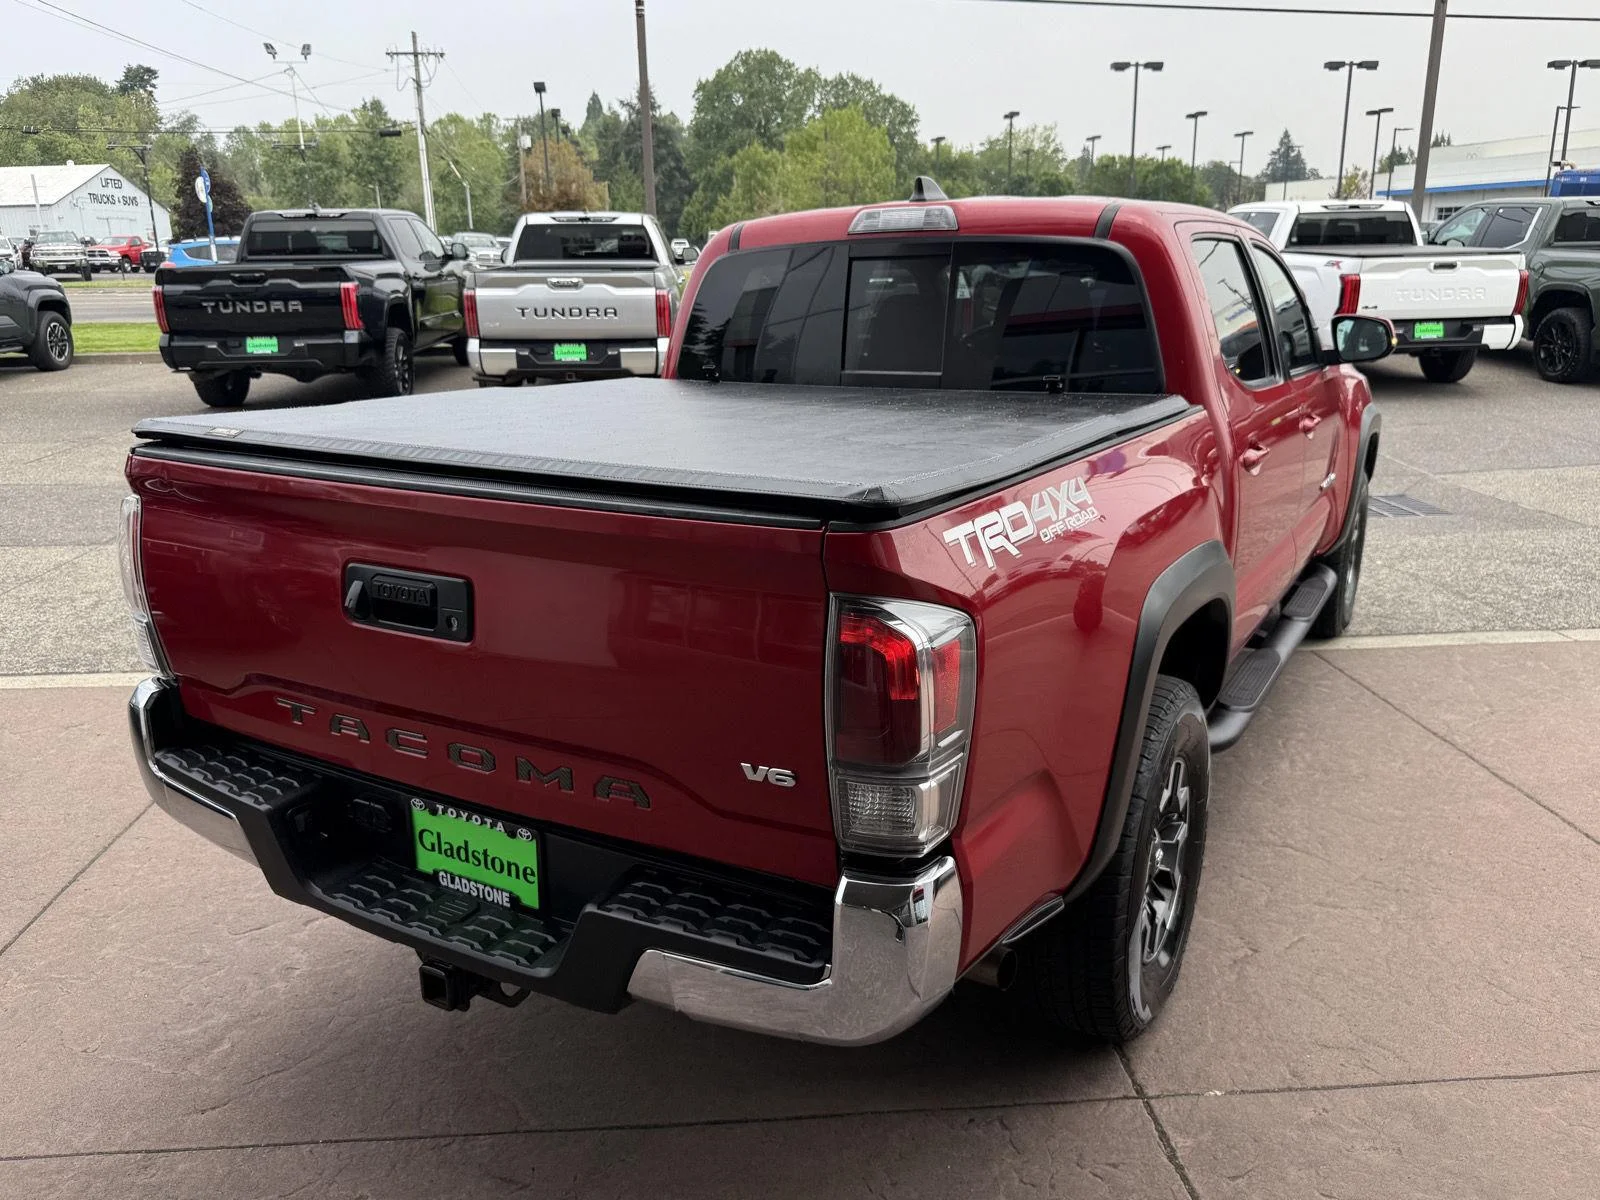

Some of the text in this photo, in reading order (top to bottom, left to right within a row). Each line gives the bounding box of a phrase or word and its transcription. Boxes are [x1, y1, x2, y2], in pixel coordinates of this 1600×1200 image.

[100, 177, 123, 189] LIFTED
[88, 192, 117, 205] TRUCKS
[201, 300, 303, 314] TUNDRA
[1395, 287, 1487, 301] TUNDRA
[516, 307, 619, 320] TUNDRA
[942, 501, 1038, 570] TRD
[1039, 507, 1102, 543] OFF ROAD
[375, 583, 429, 605] TOYOTA
[275, 697, 652, 811] TACOMA
[740, 762, 797, 788] V6
[435, 803, 506, 833] TOYOTA
[417, 828, 537, 885] Gladstone
[438, 870, 511, 908] GLADSTONE
